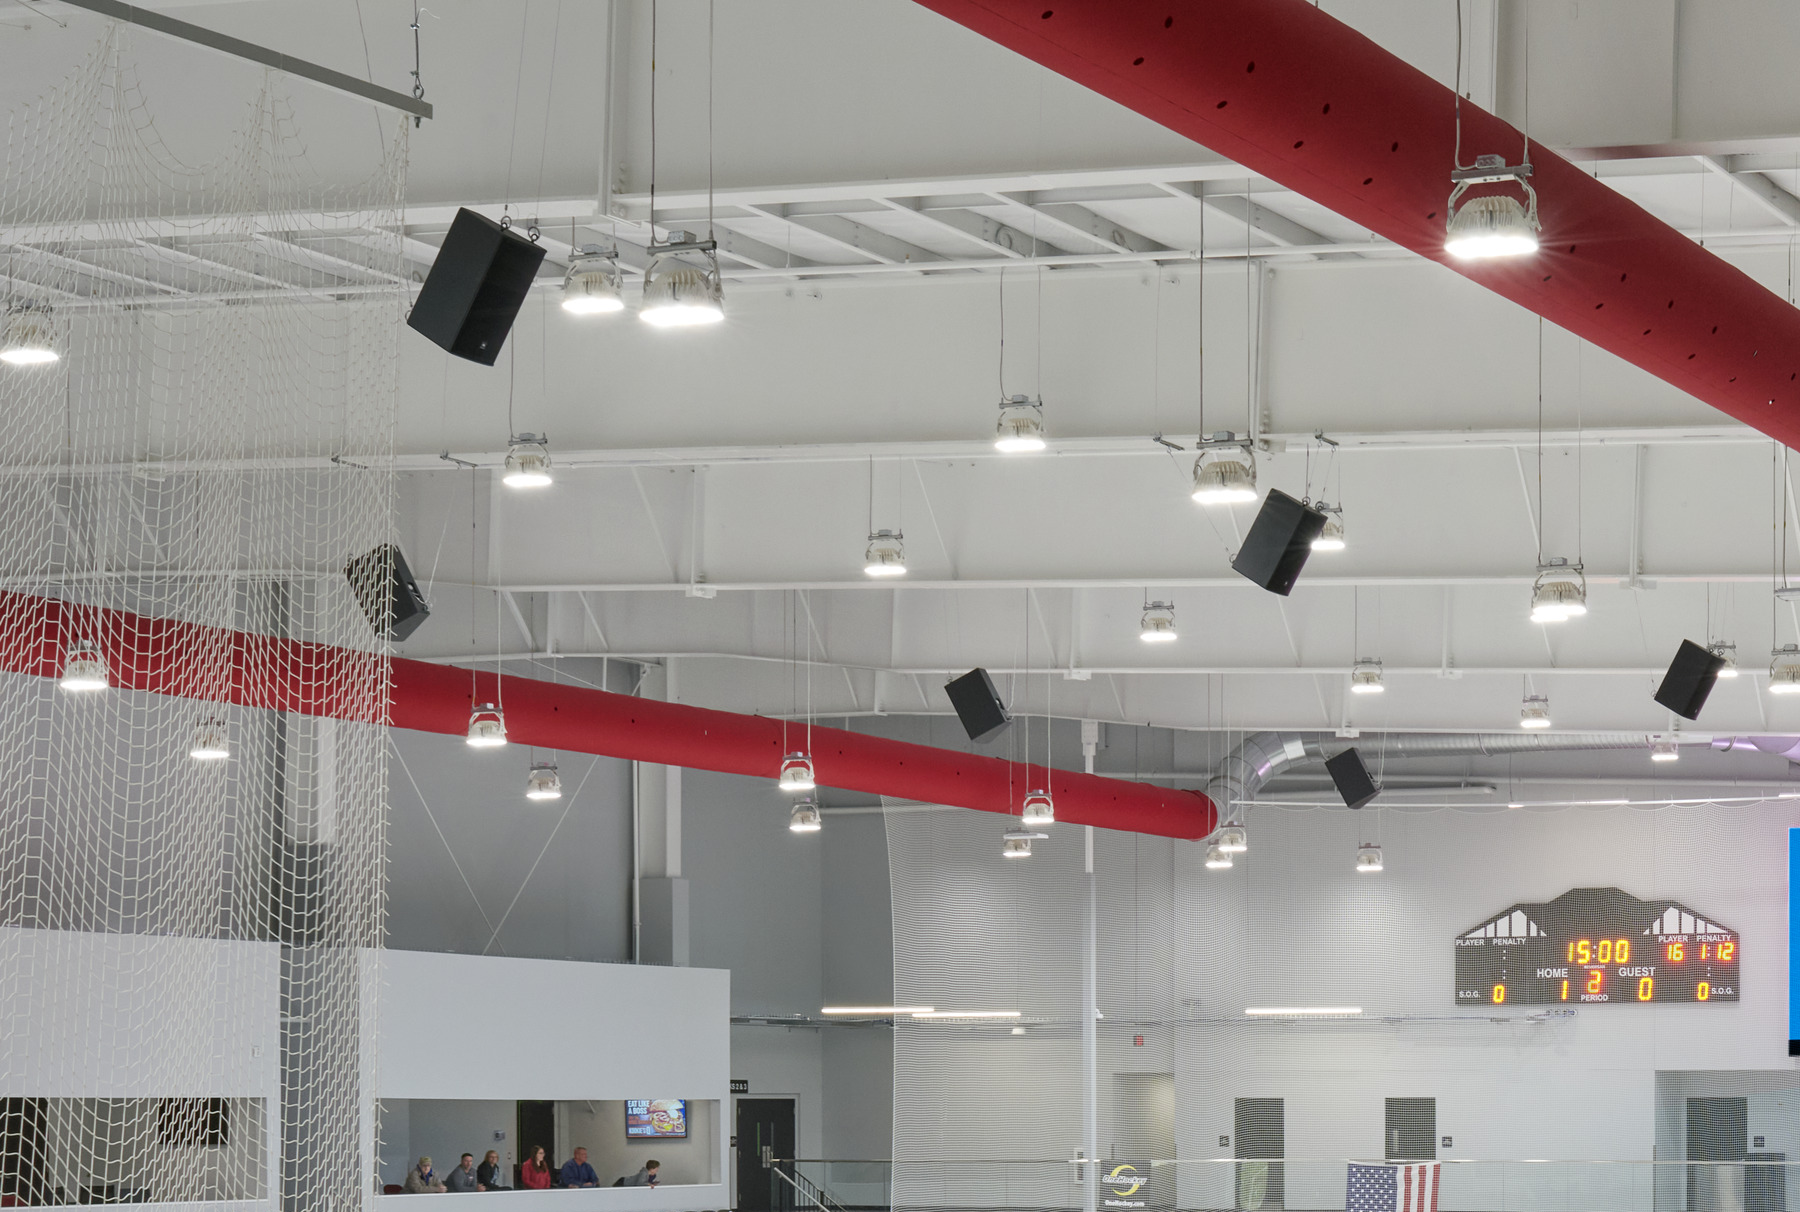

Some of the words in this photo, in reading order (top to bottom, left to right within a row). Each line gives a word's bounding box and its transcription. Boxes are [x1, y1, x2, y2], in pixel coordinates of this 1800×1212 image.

[1696, 934, 1731, 942] PENALTY
[1567, 939, 1630, 964] 15:00
[1666, 943, 1684, 961] 16
[1701, 942, 1735, 960] 1:12
[1537, 968, 1568, 978] HOME
[1618, 967, 1656, 977] GUEST
[1561, 980, 1568, 1000] 1
[1587, 970, 1602, 993] 2
[1638, 977, 1653, 1001] 0
[1493, 985, 1505, 1003] 0
[1580, 994, 1609, 1002] PERIOD
[1697, 982, 1709, 1001] 0
[1711, 987, 1734, 995] S.O.G.
[1102, 1173, 1148, 1187] OneHockey
